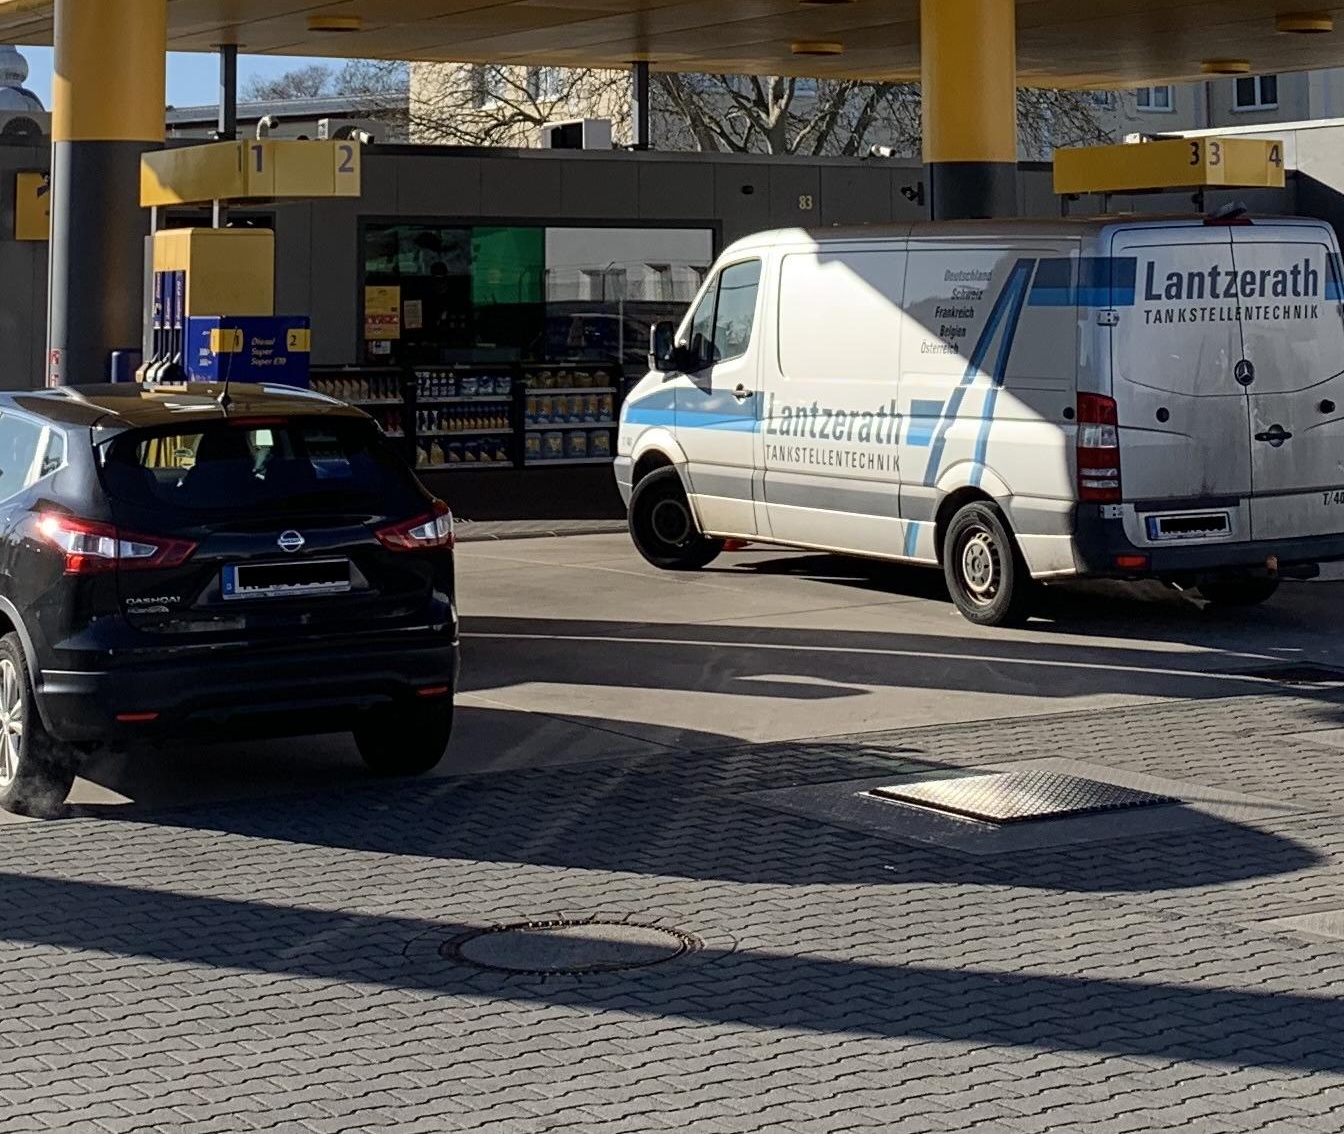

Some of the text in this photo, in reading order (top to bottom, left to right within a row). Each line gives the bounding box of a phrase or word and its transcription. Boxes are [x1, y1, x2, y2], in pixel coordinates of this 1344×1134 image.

[251, 144, 355, 173] 1 2
[1189, 141, 1200, 166] 3
[1209, 141, 1282, 168] 3 4
[799, 195, 813, 210] 83
[944, 268, 993, 281] Deutschland
[1144, 258, 1319, 301] Lantzerath
[951, 287, 984, 300] Schweiz
[935, 306, 975, 318] Frankreich
[1144, 304, 1319, 325] TANKSTELLENTECHNIK
[939, 324, 966, 339] Belgien
[251, 337, 276, 346] Diesel
[289, 334, 297, 346] 2
[920, 338, 959, 354] Österreich
[251, 348, 273, 357] Super
[250, 357, 272, 367] Super
[766, 392, 903, 445] Lantzerath
[766, 444, 900, 471] TANKSTELLENTECHNIK
